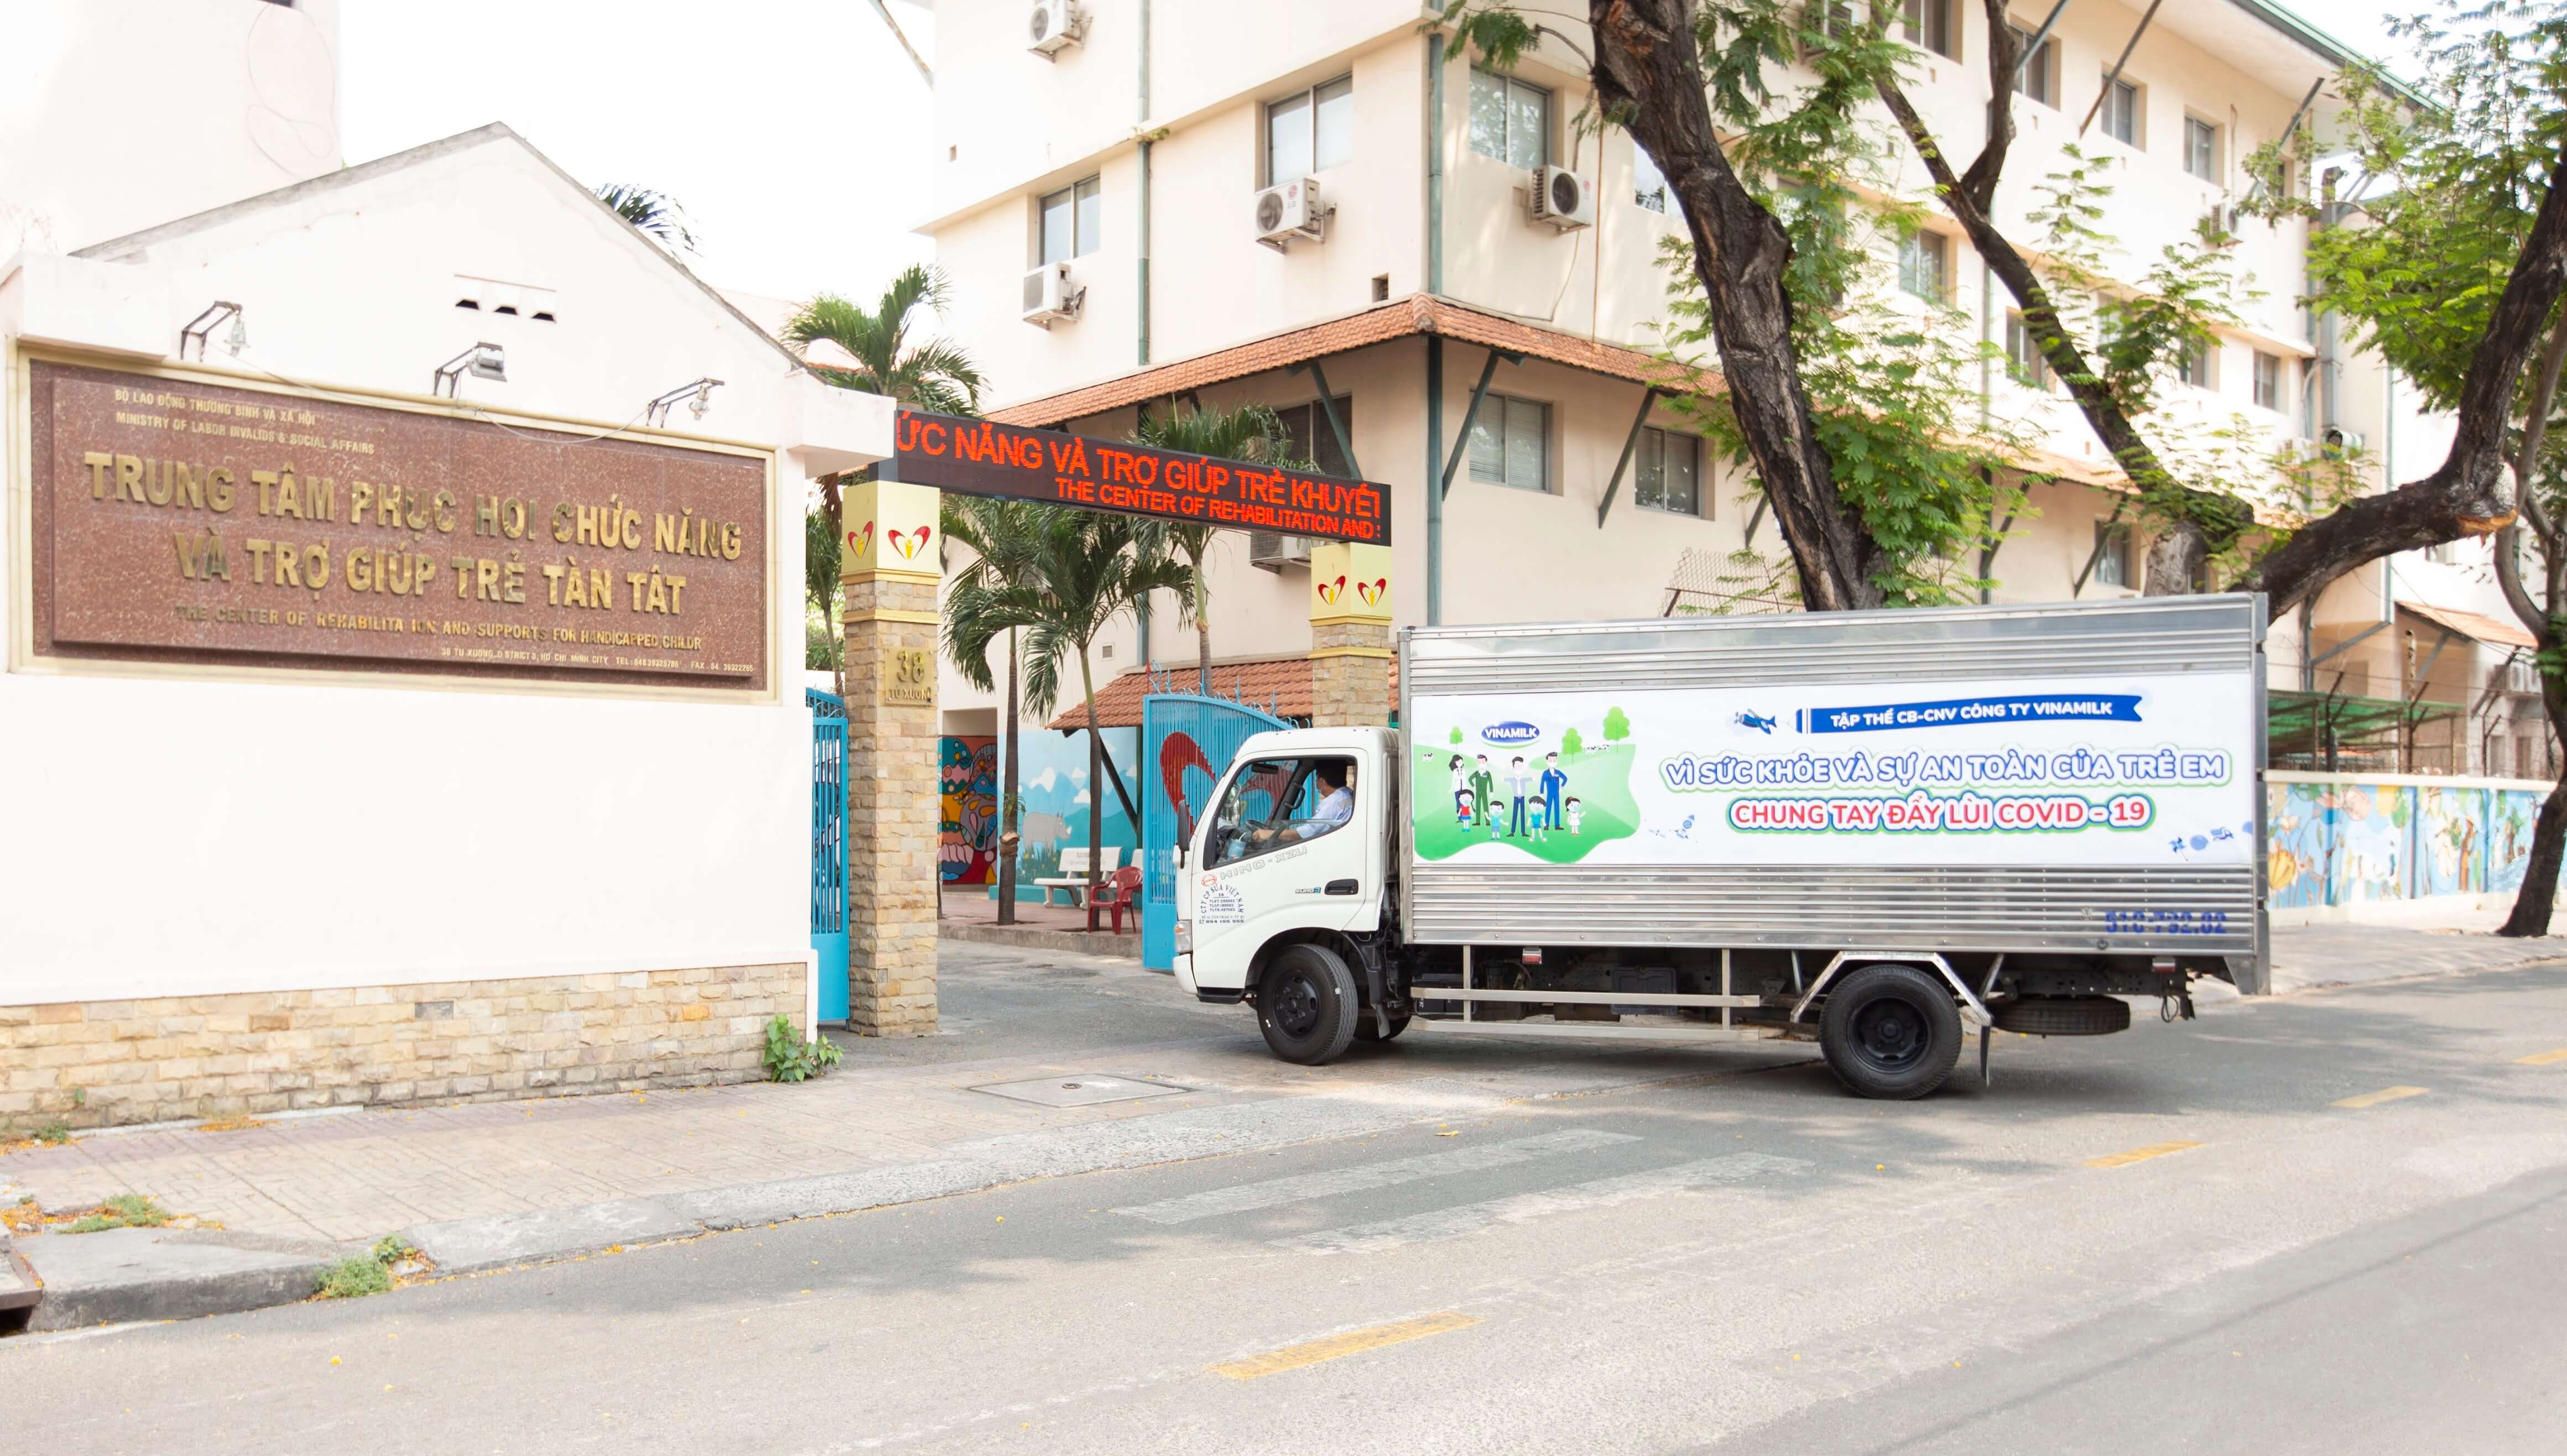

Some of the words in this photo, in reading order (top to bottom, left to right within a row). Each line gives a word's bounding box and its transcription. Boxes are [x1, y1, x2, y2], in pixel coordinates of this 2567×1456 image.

[133, 392, 154, 405] LAO
[236, 405, 259, 419] BINH
[116, 412, 170, 429] MINISTRY
[173, 419, 187, 431] OF
[192, 421, 226, 436] LABOR
[230, 425, 275, 442] INVALIDS
[278, 433, 286, 443] &
[290, 434, 327, 448] SOCIAL
[331, 439, 375, 455] AFFAIRS
[955, 422, 1044, 470] NĂNG
[1049, 436, 1091, 477] VÀ
[1096, 447, 1160, 490] TRỢ
[1164, 455, 1230, 496] GIÚP
[1234, 468, 1287, 506] TRẺ
[84, 451, 236, 514] TRUNG
[251, 461, 335, 522] TÂM
[350, 479, 457, 542] PHỤC
[553, 494, 642, 550] CHỨC
[655, 506, 742, 561] NĂNG
[1055, 477, 1096, 503] THE
[1100, 484, 1177, 514] CENTER
[1180, 495, 1206, 516] OF
[1208, 498, 1340, 534] REHABILITATION
[1341, 518, 1374, 540] AND
[174, 525, 232, 582] VÀ
[246, 536, 330, 602] TRỢ
[346, 540, 437, 596] GIÚP
[451, 547, 527, 603] TRẺ
[543, 555, 613, 609] TÀN
[176, 603, 208, 620] THE
[215, 606, 279, 625] CENTER
[286, 609, 307, 626] OF
[442, 620, 470, 636] AND
[477, 623, 547, 641] SUPPORTS
[553, 628, 577, 643] FOR
[581, 630, 659, 648] HANDICAPPED
[663, 635, 702, 650] CHILDR
[554, 654, 567, 662] CHI
[570, 654, 589, 663] MINH
[592, 655, 608, 665] CITY
[897, 650, 925, 683] 38
[1485, 728, 1538, 738] VINAMILK
[1830, 712, 1861, 730] TẬP
[1863, 707, 1894, 726] THỂ
[1897, 707, 1957, 723] CB-CNV
[1960, 703, 2006, 719] CÔNG
[2008, 703, 2030, 716] TY
[2033, 702, 2113, 715] VINAMILK
[1666, 758, 1694, 785] VÌ
[1699, 755, 1752, 784] SỨC
[1757, 752, 1830, 784] KHỎE
[1834, 752, 1873, 782] VÀ
[1877, 751, 1918, 787] SỰ
[1920, 754, 1962, 781] AN
[1966, 749, 2046, 780] TOÀN
[2053, 748, 2115, 779] CỦA
[2118, 749, 2177, 779] TRẺ
[2181, 754, 2224, 779] EM
[1735, 804, 1824, 824] CHUNG
[1832, 804, 1879, 823] TAY
[1886, 796, 1940, 823] ĐẨY
[1949, 798, 1988, 824] LÙI
[1998, 802, 2084, 823] COVID
[2113, 801, 2145, 821] 19
